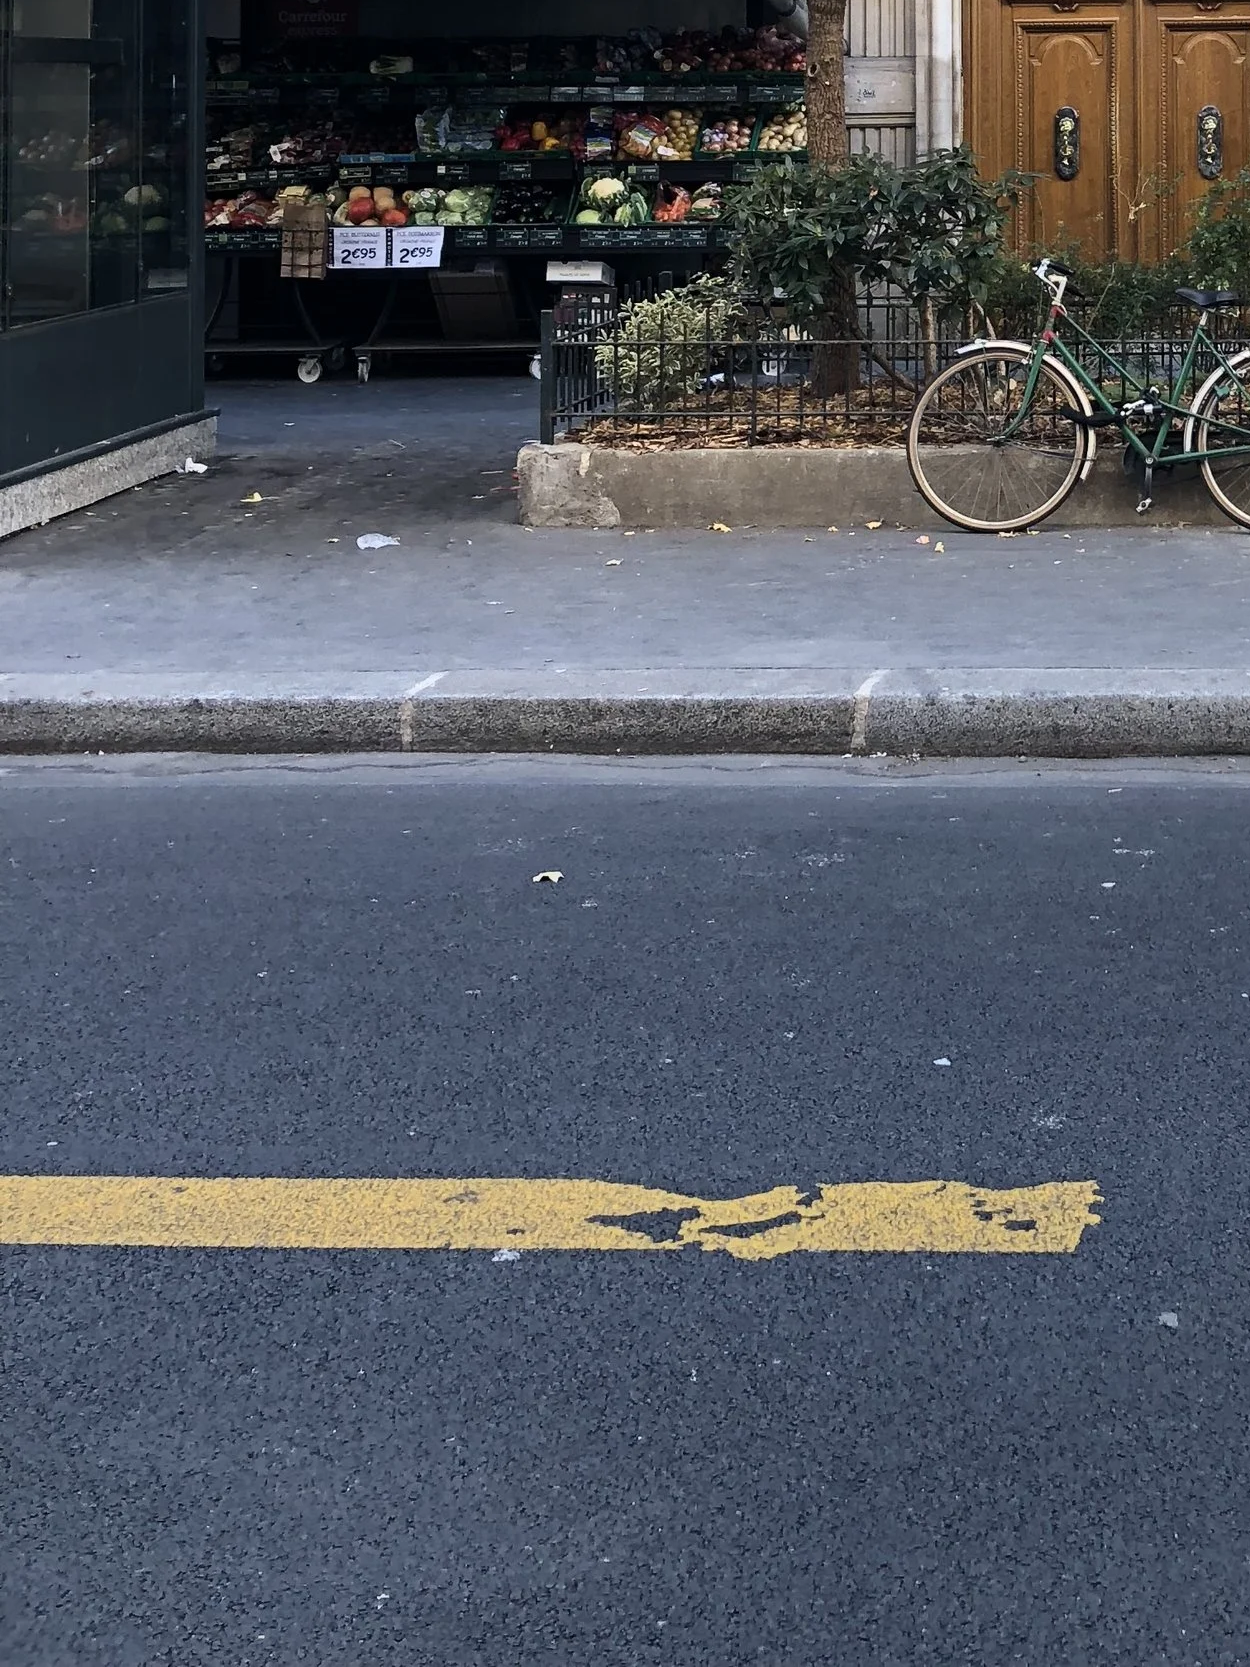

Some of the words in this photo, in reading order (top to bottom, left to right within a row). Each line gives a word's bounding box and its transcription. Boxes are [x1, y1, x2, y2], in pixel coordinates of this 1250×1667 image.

[278, 10, 347, 23] Carrefour
[341, 248, 377, 265] 2€95
[399, 247, 433, 264] 2€95
